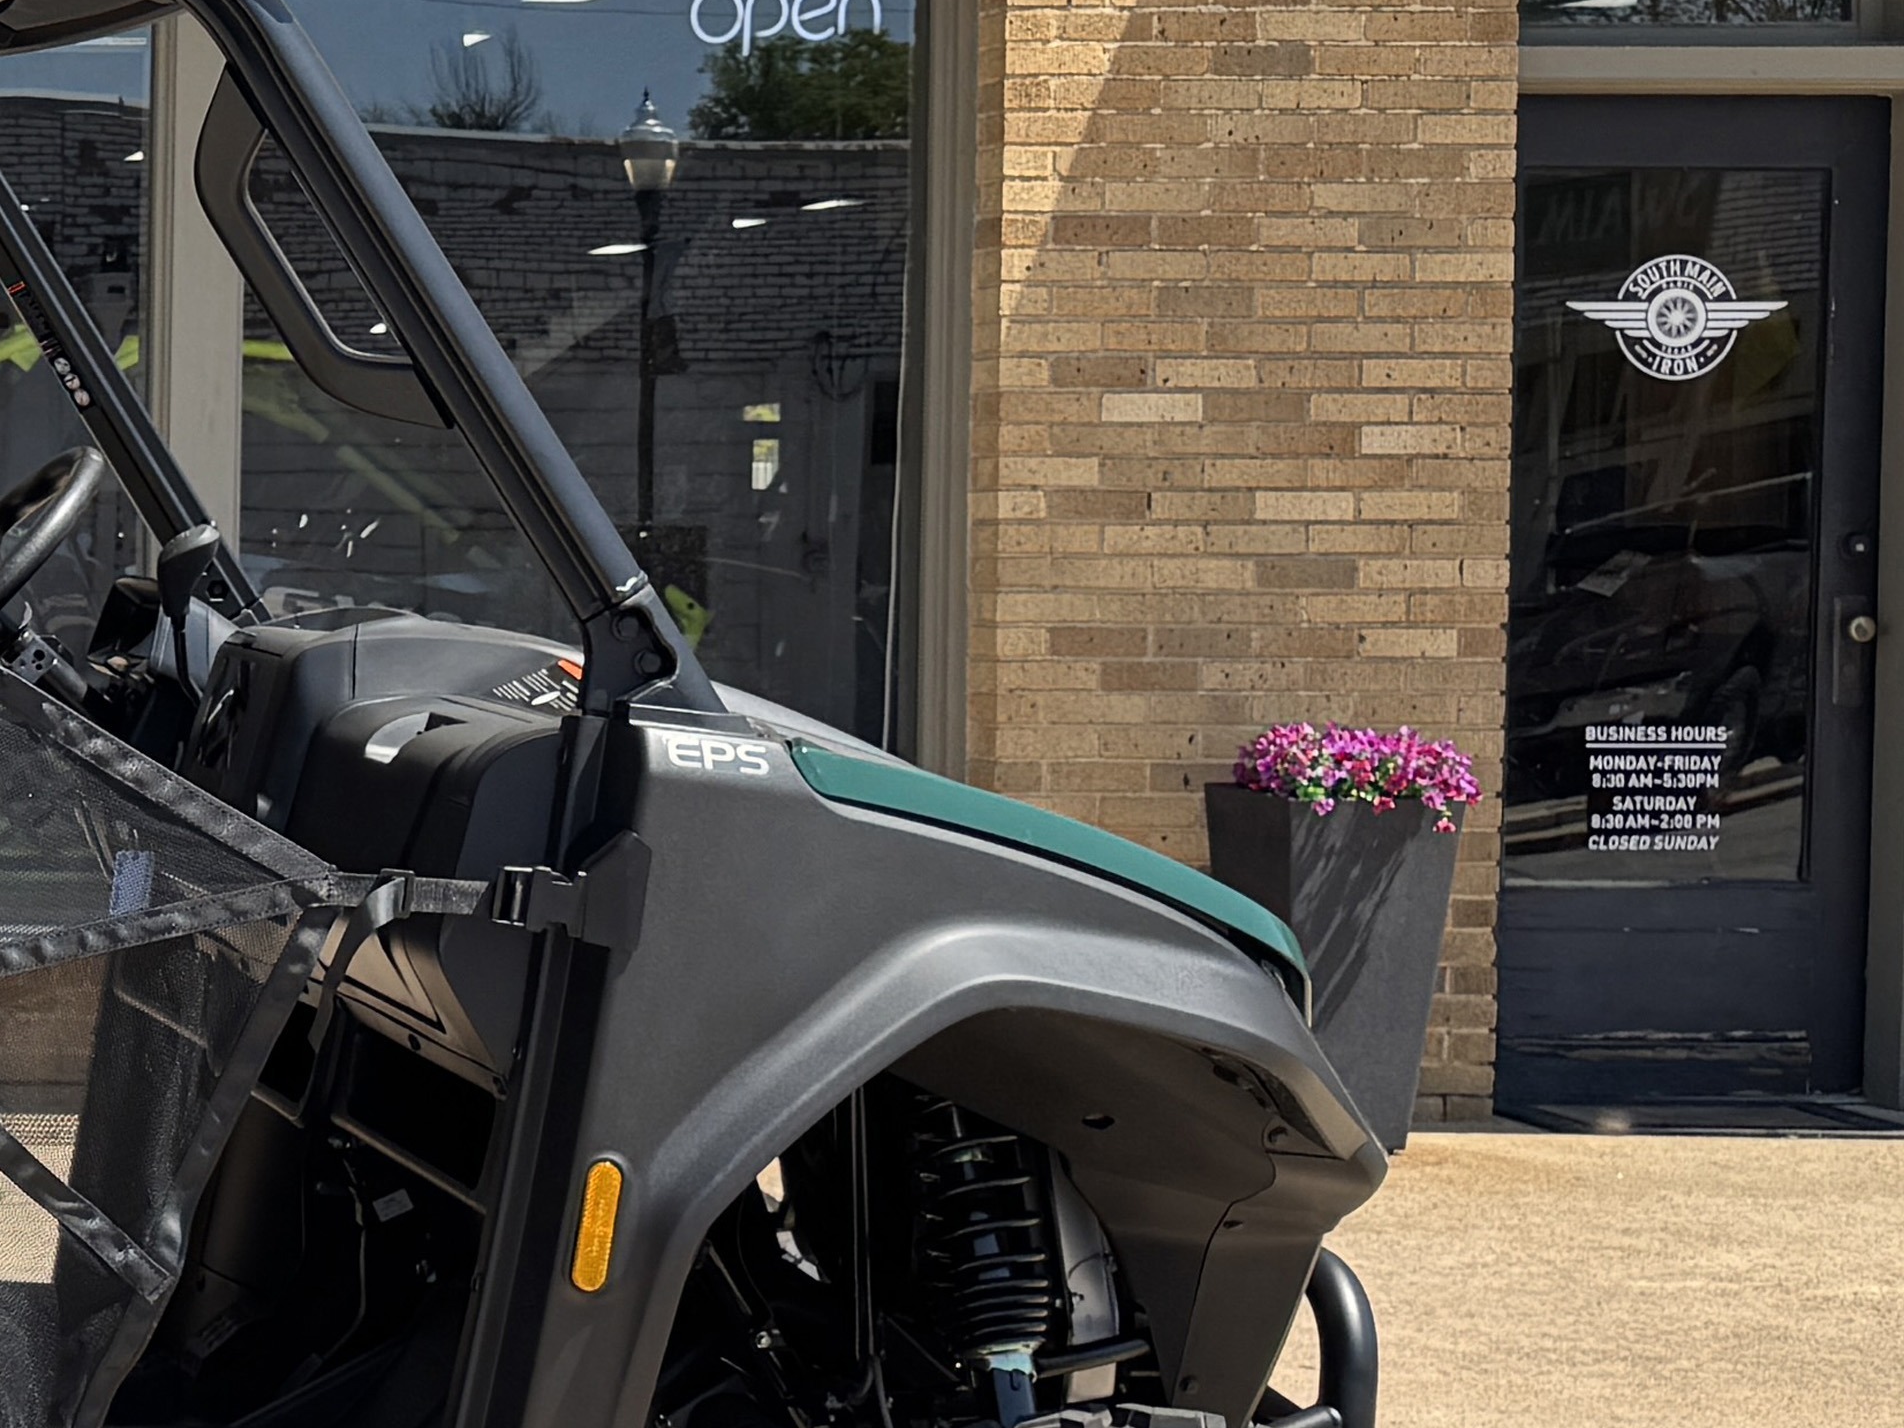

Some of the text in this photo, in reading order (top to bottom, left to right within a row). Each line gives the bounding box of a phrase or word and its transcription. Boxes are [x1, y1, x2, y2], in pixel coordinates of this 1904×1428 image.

[1629, 259, 1726, 297] SOUTH MAIN
[1652, 356, 1699, 375] IRON
[1585, 725, 1728, 742] BUSINESS HOURS
[664, 735, 771, 776] EPS
[1589, 754, 1722, 771] MONDAY-FRIDAY
[1612, 795, 1697, 811] SATURDAY
[1696, 814, 1720, 829] PM
[1588, 835, 1719, 851] CLOSED SUNDAY
